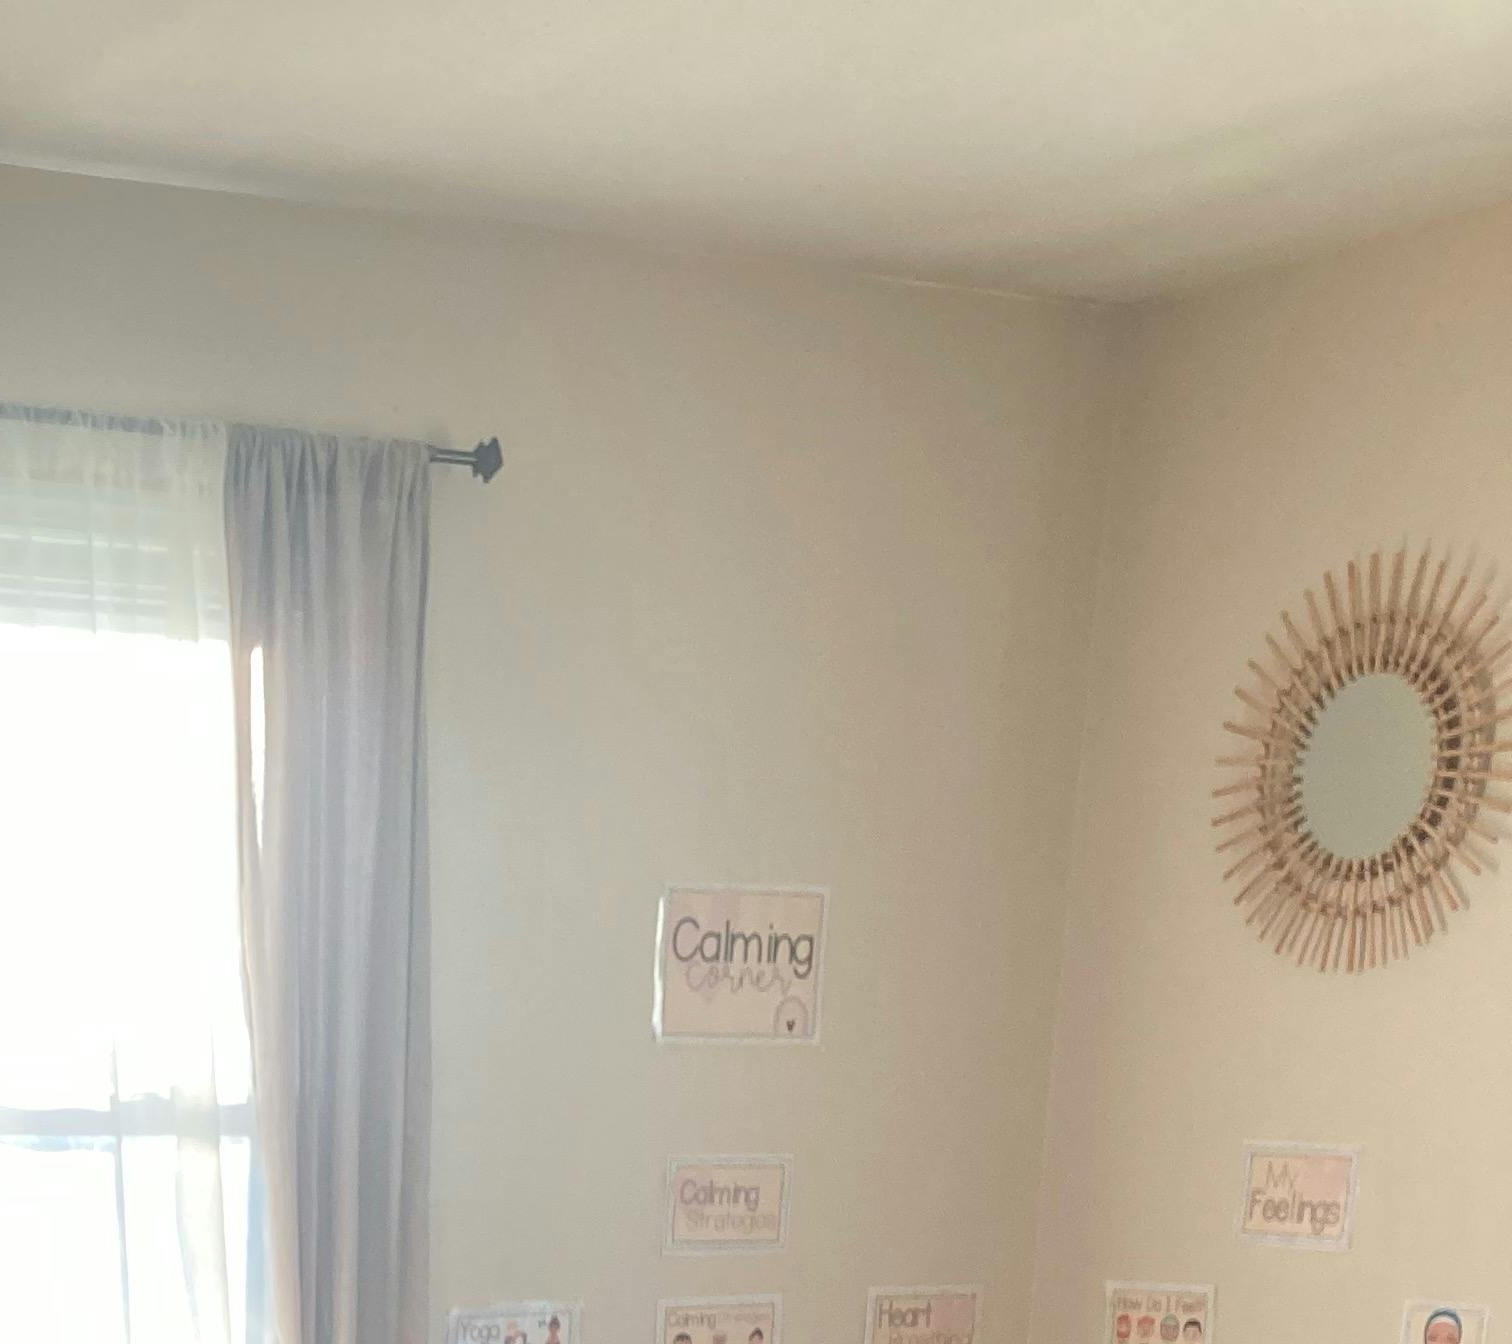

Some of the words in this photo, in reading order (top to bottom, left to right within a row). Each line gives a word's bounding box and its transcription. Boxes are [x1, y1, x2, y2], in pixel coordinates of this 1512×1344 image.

[673, 916, 814, 980] Calming
[1266, 1160, 1296, 1190] My
[680, 1179, 760, 1212] Calming
[1250, 1188, 1341, 1235] Feelings
[669, 1311, 717, 1330] Calming
[879, 1299, 932, 1328] Heart
